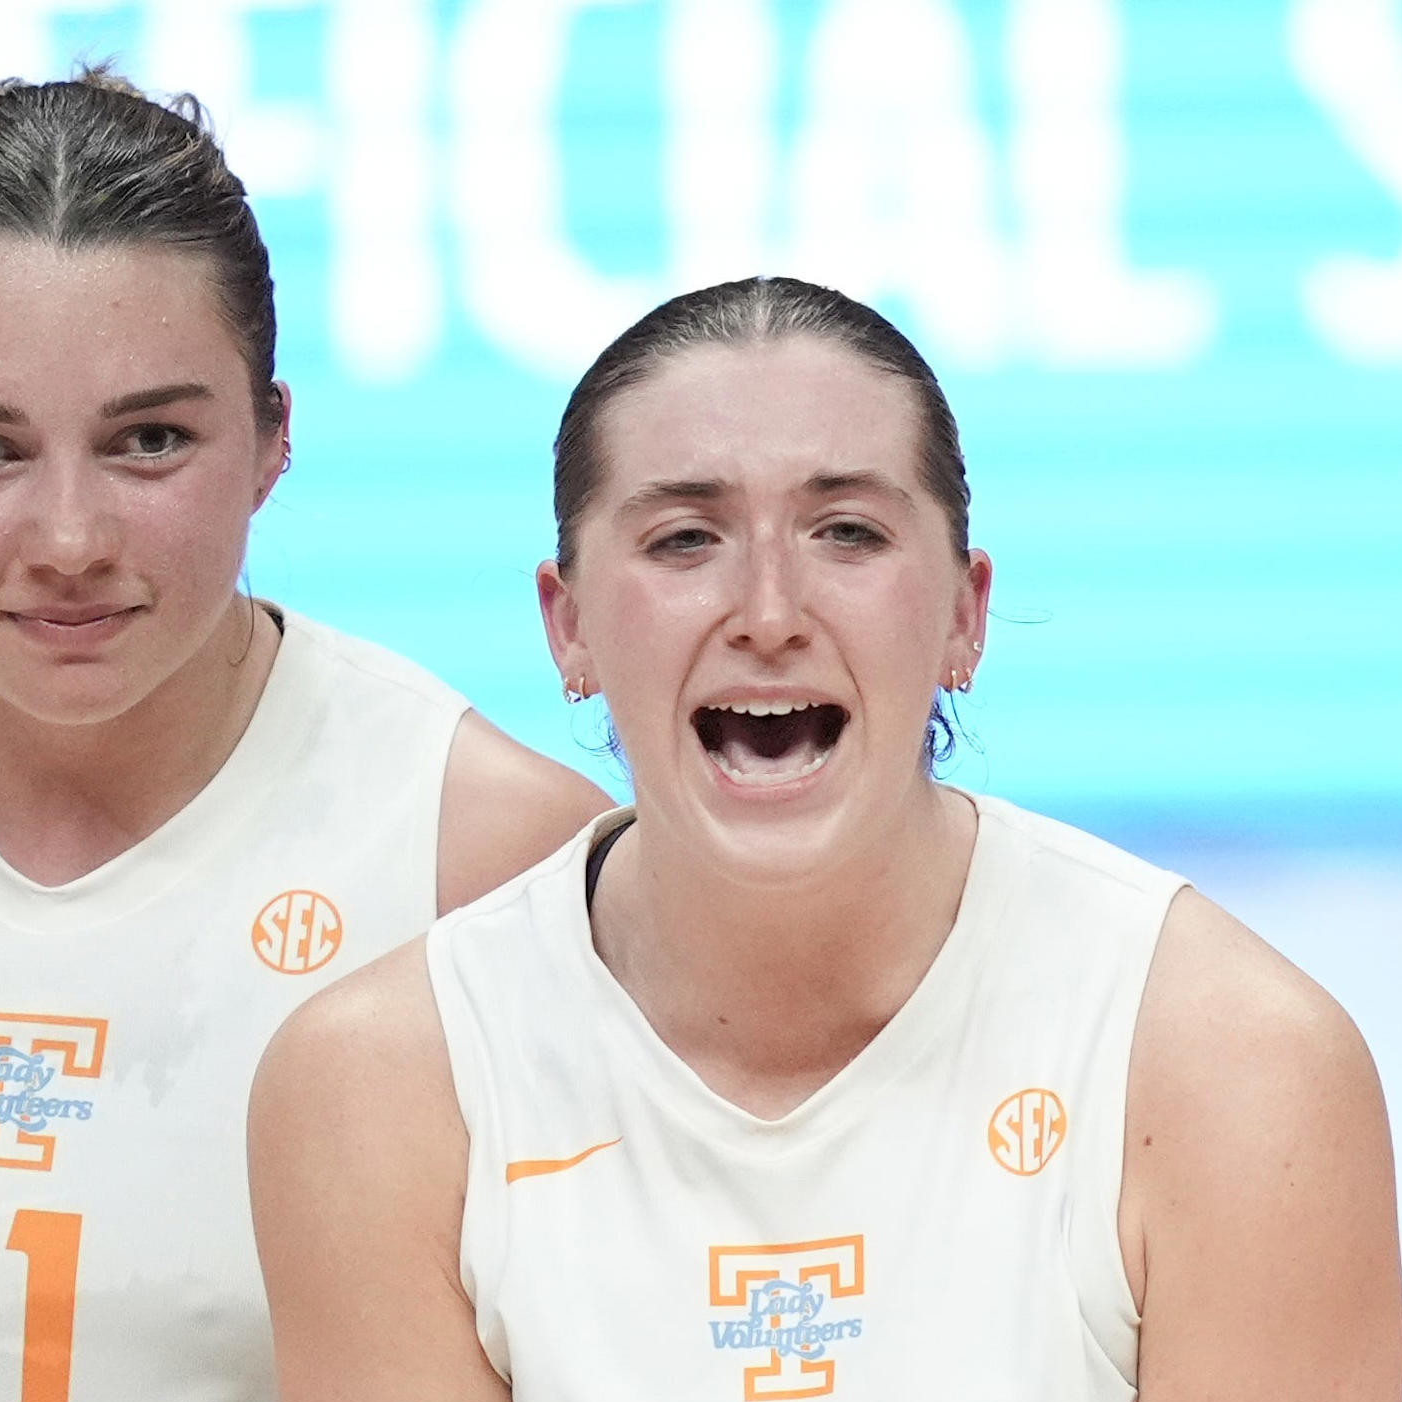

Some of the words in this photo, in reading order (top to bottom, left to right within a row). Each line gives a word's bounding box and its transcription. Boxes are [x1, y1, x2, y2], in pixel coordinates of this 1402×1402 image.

[254, 892, 340, 972] SEC
[990, 1090, 1066, 1175] SEC
[749, 1280, 824, 1322] Lady
[709, 1316, 862, 1360] Volunteers
